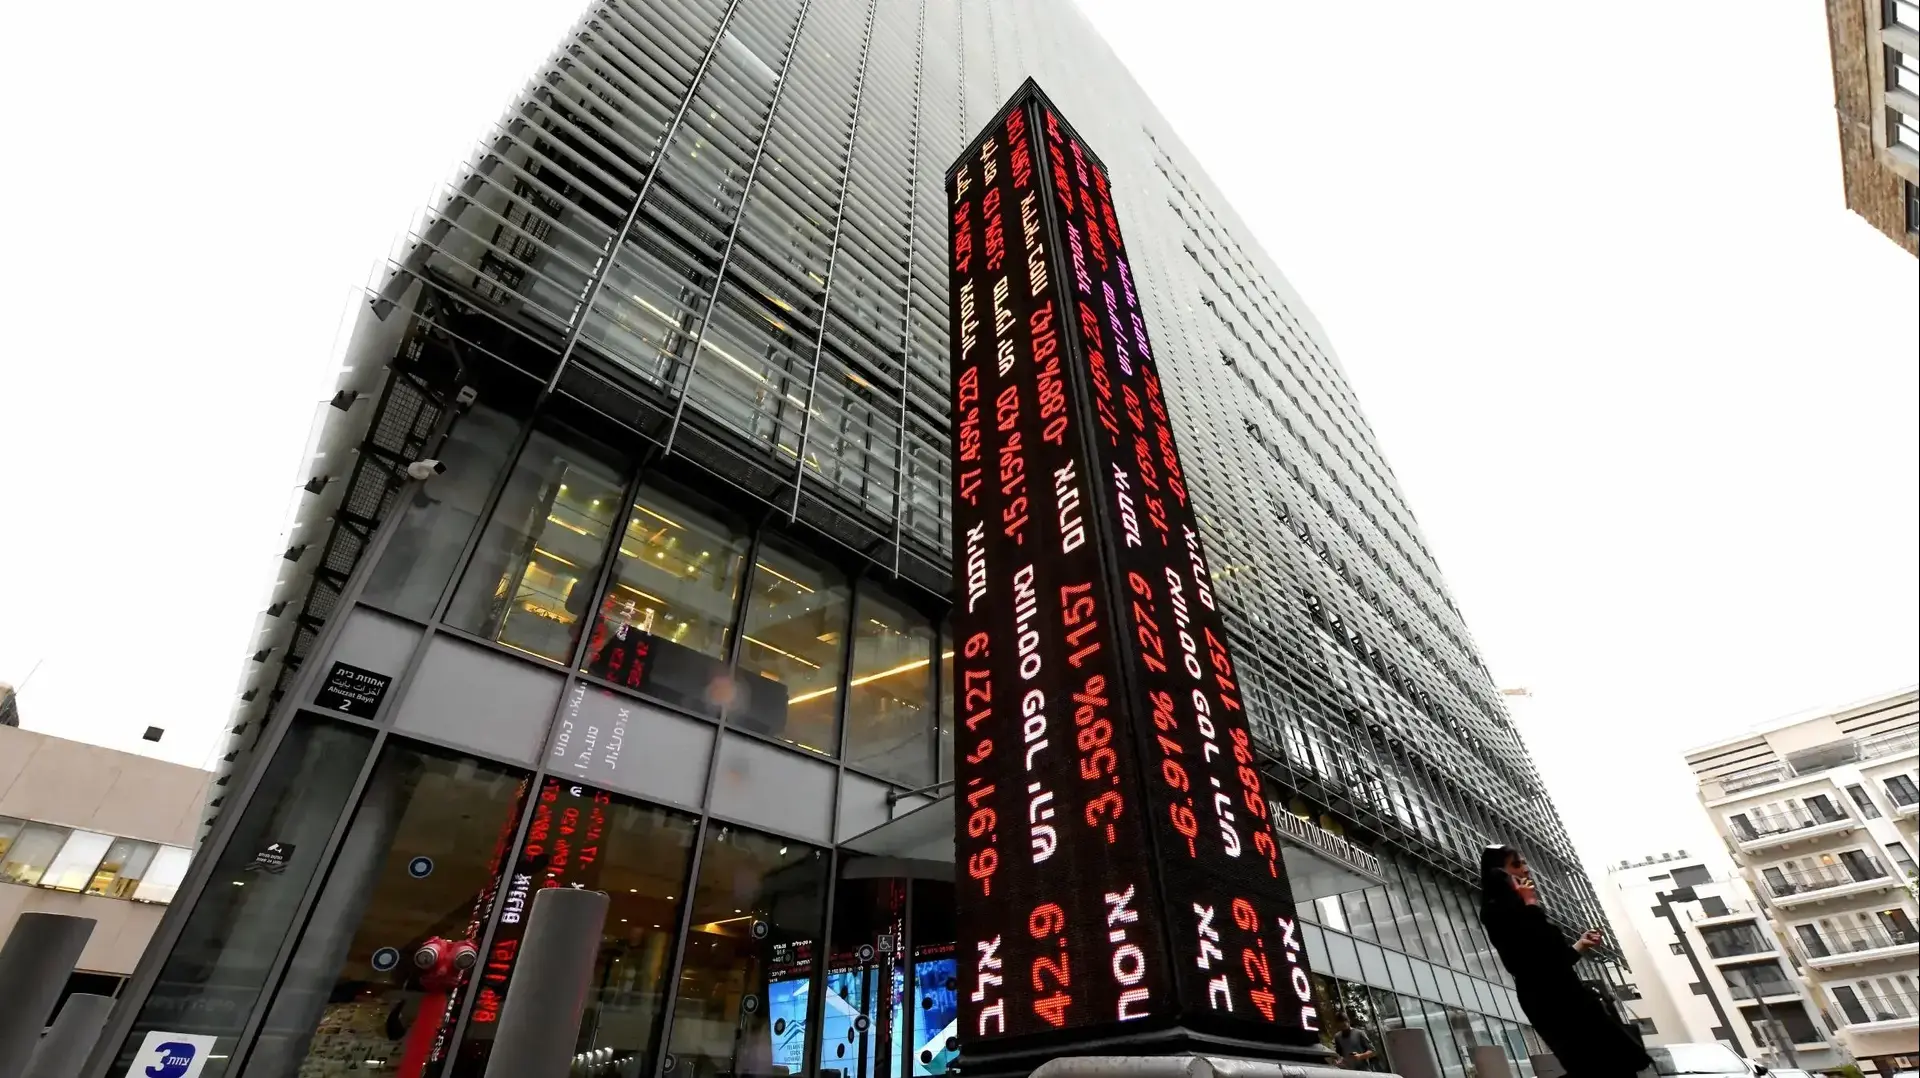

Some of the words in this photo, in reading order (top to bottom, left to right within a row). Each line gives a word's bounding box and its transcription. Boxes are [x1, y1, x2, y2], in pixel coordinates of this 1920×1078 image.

[960, 278, 978, 359] אינטרקיור
[993, 275, 1015, 336] מודיעין
[1029, 300, 1056, 361] 8742
[1079, 301, 1102, 348] 220
[1102, 280, 1127, 341] מודיעין
[959, 366, 978, 411] 220
[997, 339, 1014, 376] יהש
[1088, 346, 1119, 445] -17.45%
[1114, 336, 1132, 375] יהש
[996, 385, 1018, 430] 420
[1036, 357, 1067, 444] -0.88%
[1122, 384, 1144, 430] 420
[959, 407, 981, 504] -17.45%
[999, 432, 1027, 543] -15.15%
[1133, 435, 1168, 544] -15.15%
[1054, 459, 1084, 552] אינרום
[1112, 463, 1141, 546] איתמר
[967, 521, 985, 612] איתמר
[1130, 312, 1151, 360] ביטוח
[1142, 365, 1166, 423] 8742
[1155, 422, 1185, 506] -0.88%
[1182, 524, 1215, 611] אינרום
[1204, 627, 1241, 711] 1157
[1229, 728, 1276, 876] -3.58%
[1013, 564, 1040, 679] נאוויטס
[1060, 583, 1099, 666] 1157
[1128, 572, 1166, 671] 127.9
[1165, 567, 1201, 678] נאוויטס
[328, 686, 356, 698] Ahuzzat
[356, 694, 374, 703] Bayit
[336, 668, 354, 679] בית
[339, 699, 352, 711] 2
[356, 674, 385, 687] אחוזת
[964, 632, 991, 729] 127.9
[1022, 689, 1047, 770] פטר
[1073, 675, 1122, 841] -3.58%
[1192, 688, 1219, 761] פטר
[1150, 691, 1197, 856] -6.91%
[1028, 782, 1056, 862] יהש
[1210, 777, 1240, 856] יהש
[971, 935, 1004, 1034] אלב
[1029, 903, 1070, 1025] 42.9
[1193, 903, 1232, 1011] אלב
[1232, 898, 1274, 1020] 42.9
[166, 1056, 190, 1066] צוות
